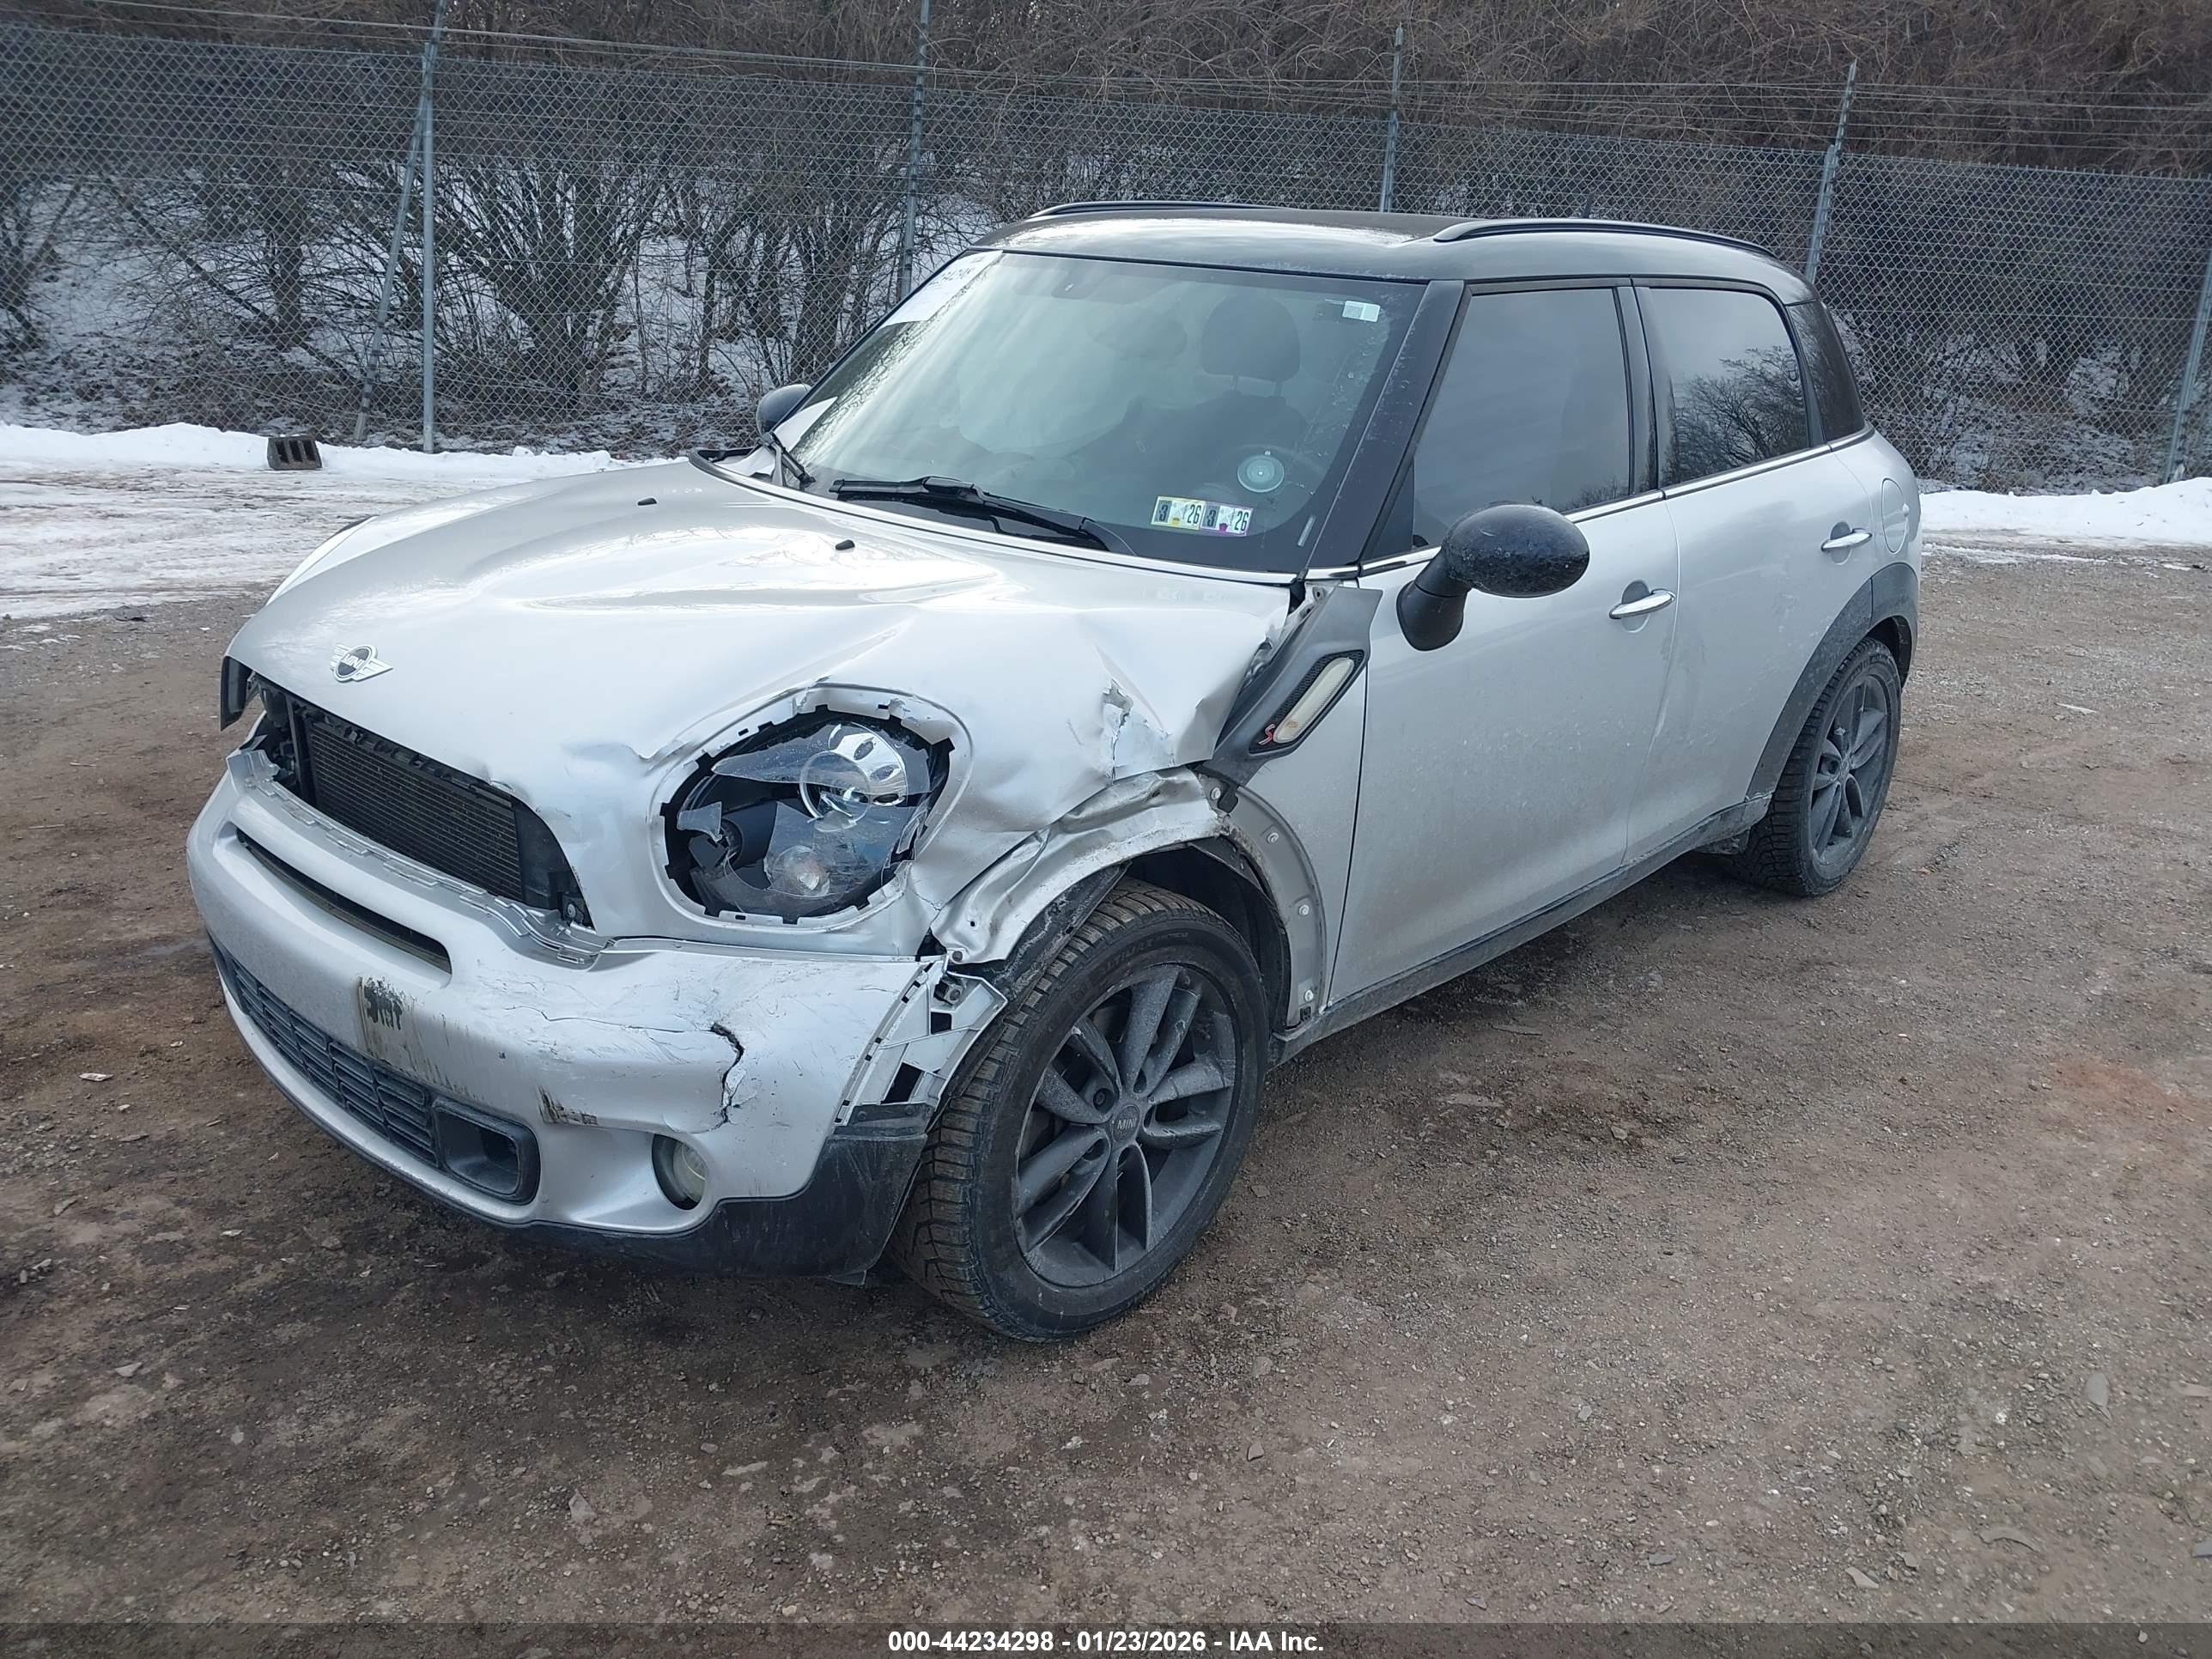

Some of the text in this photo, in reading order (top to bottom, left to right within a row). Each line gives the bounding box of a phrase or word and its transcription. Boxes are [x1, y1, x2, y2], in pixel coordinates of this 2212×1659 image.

[1159, 504, 1169, 521] 3
[1187, 504, 1201, 524] 26
[1207, 510, 1217, 526] 3
[1234, 510, 1249, 531] 26
[1257, 723, 1276, 745] S
[1117, 1118, 1137, 1130] MINI
